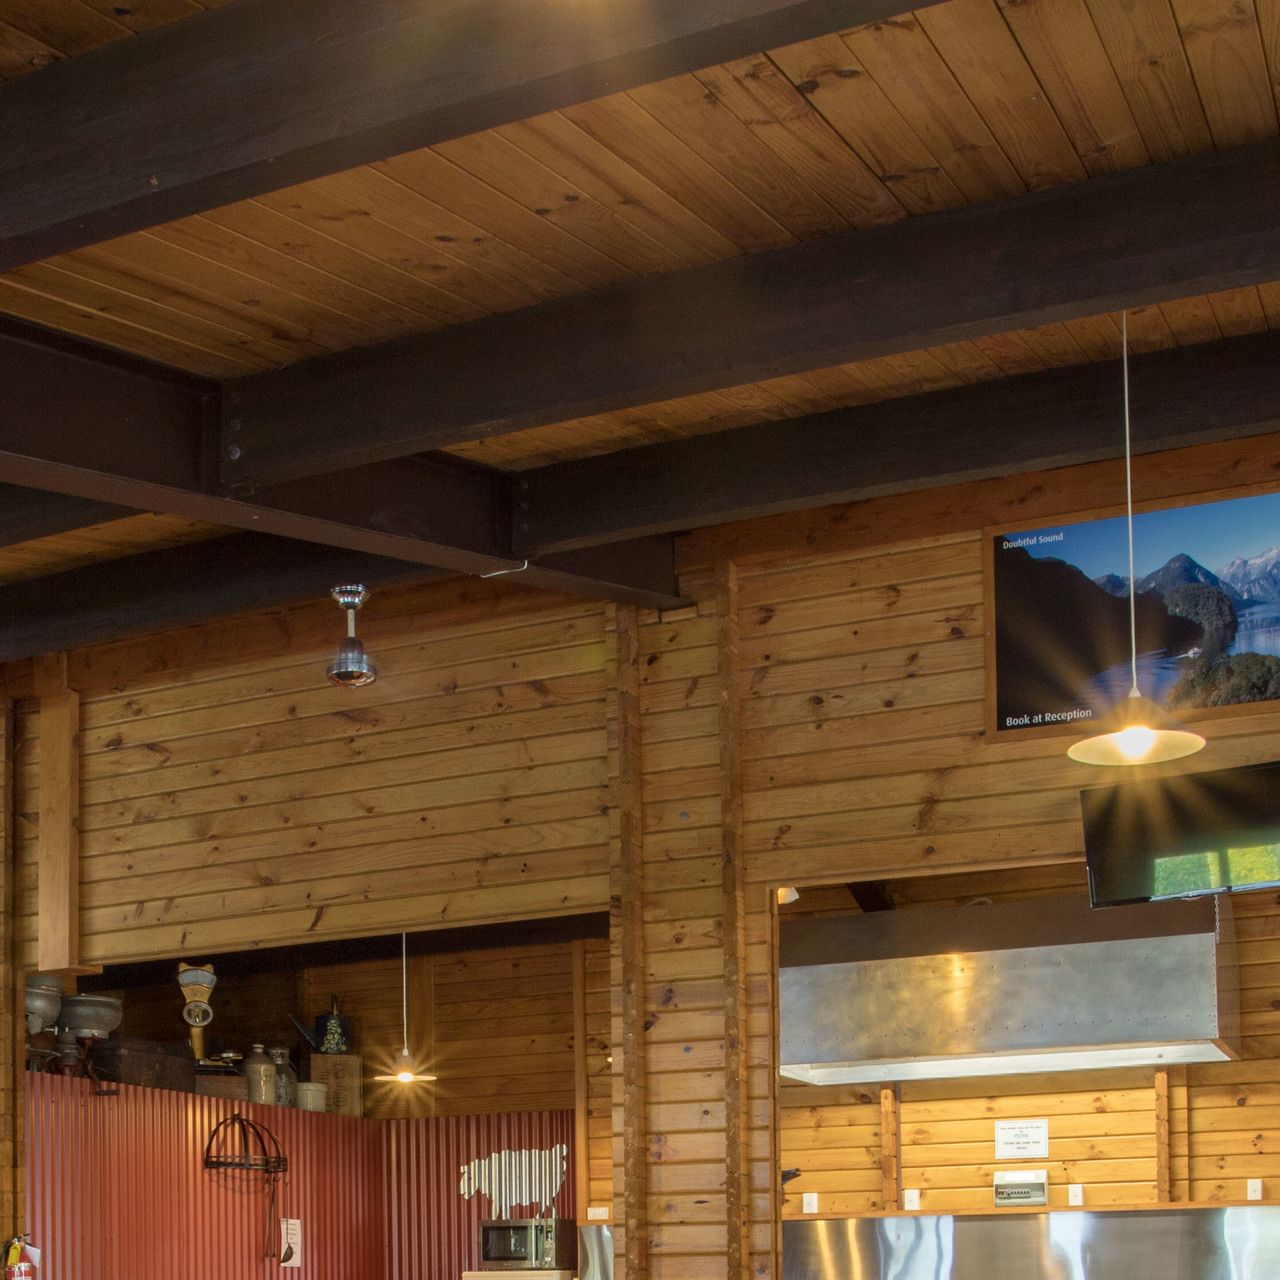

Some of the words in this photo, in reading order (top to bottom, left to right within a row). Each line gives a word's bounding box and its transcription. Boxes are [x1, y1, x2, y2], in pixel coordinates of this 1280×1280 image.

[1003, 536, 1037, 549] Doubtful
[1039, 532, 1064, 543] Sound
[1006, 715, 1030, 727] Book
[1032, 714, 1042, 723] at
[1045, 708, 1093, 722] Reception
